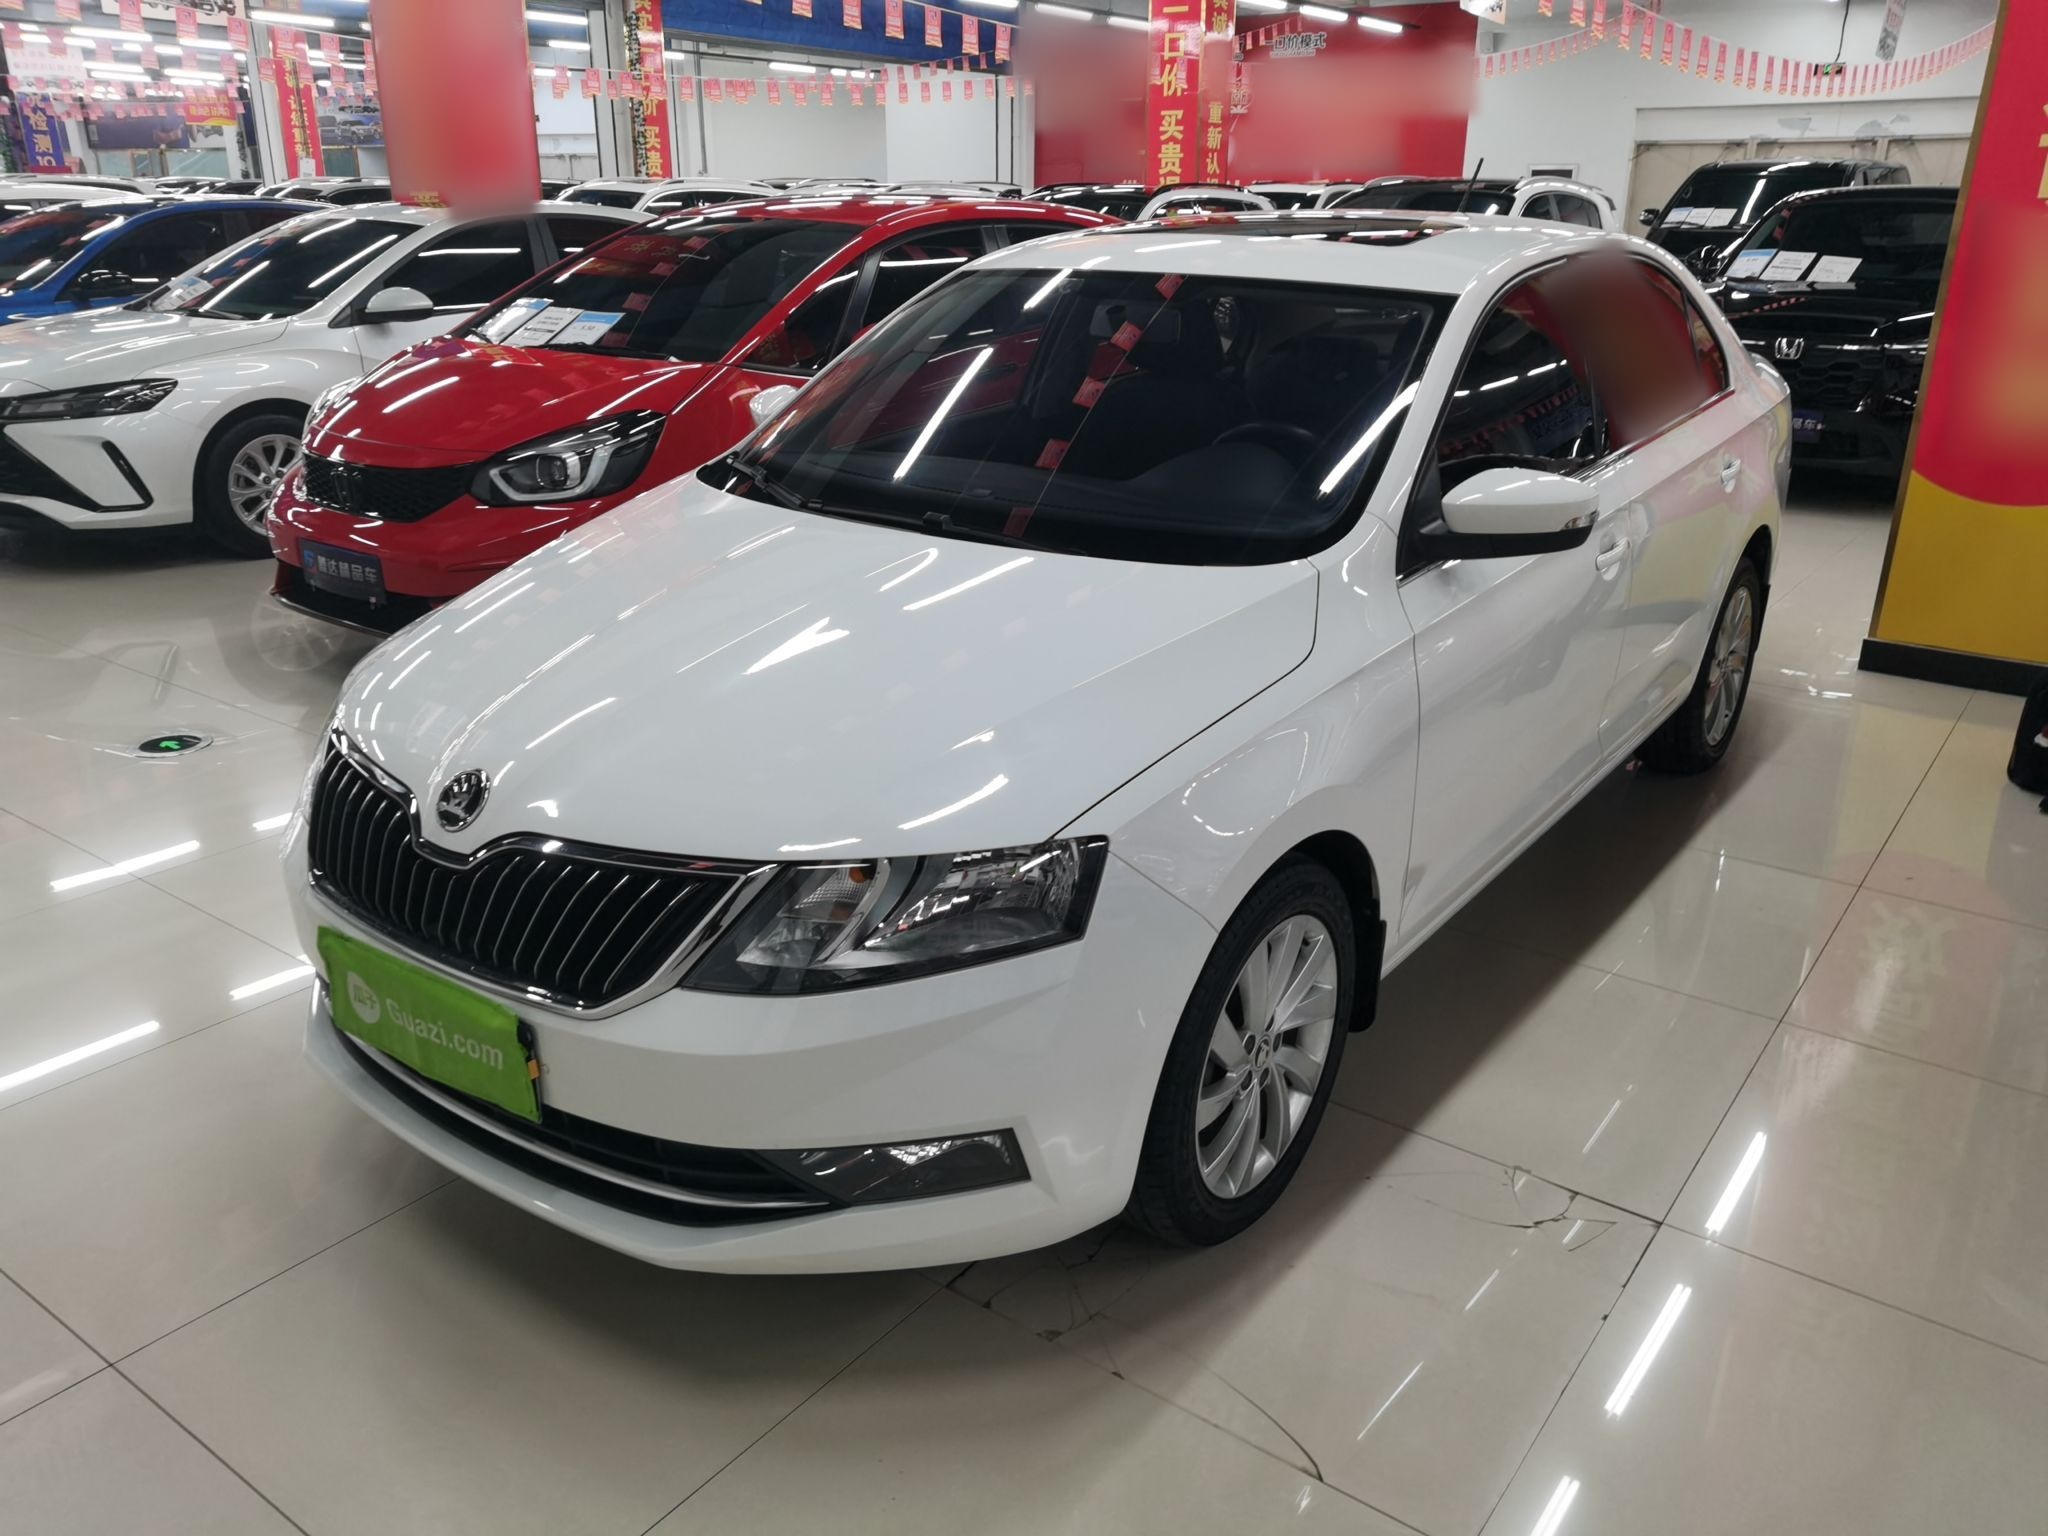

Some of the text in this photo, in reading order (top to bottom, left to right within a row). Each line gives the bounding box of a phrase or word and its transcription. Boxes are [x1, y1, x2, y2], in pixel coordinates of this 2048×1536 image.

[1264, 32, 1327, 51] 一口价模式
[386, 998, 503, 1070] Guazi.com
